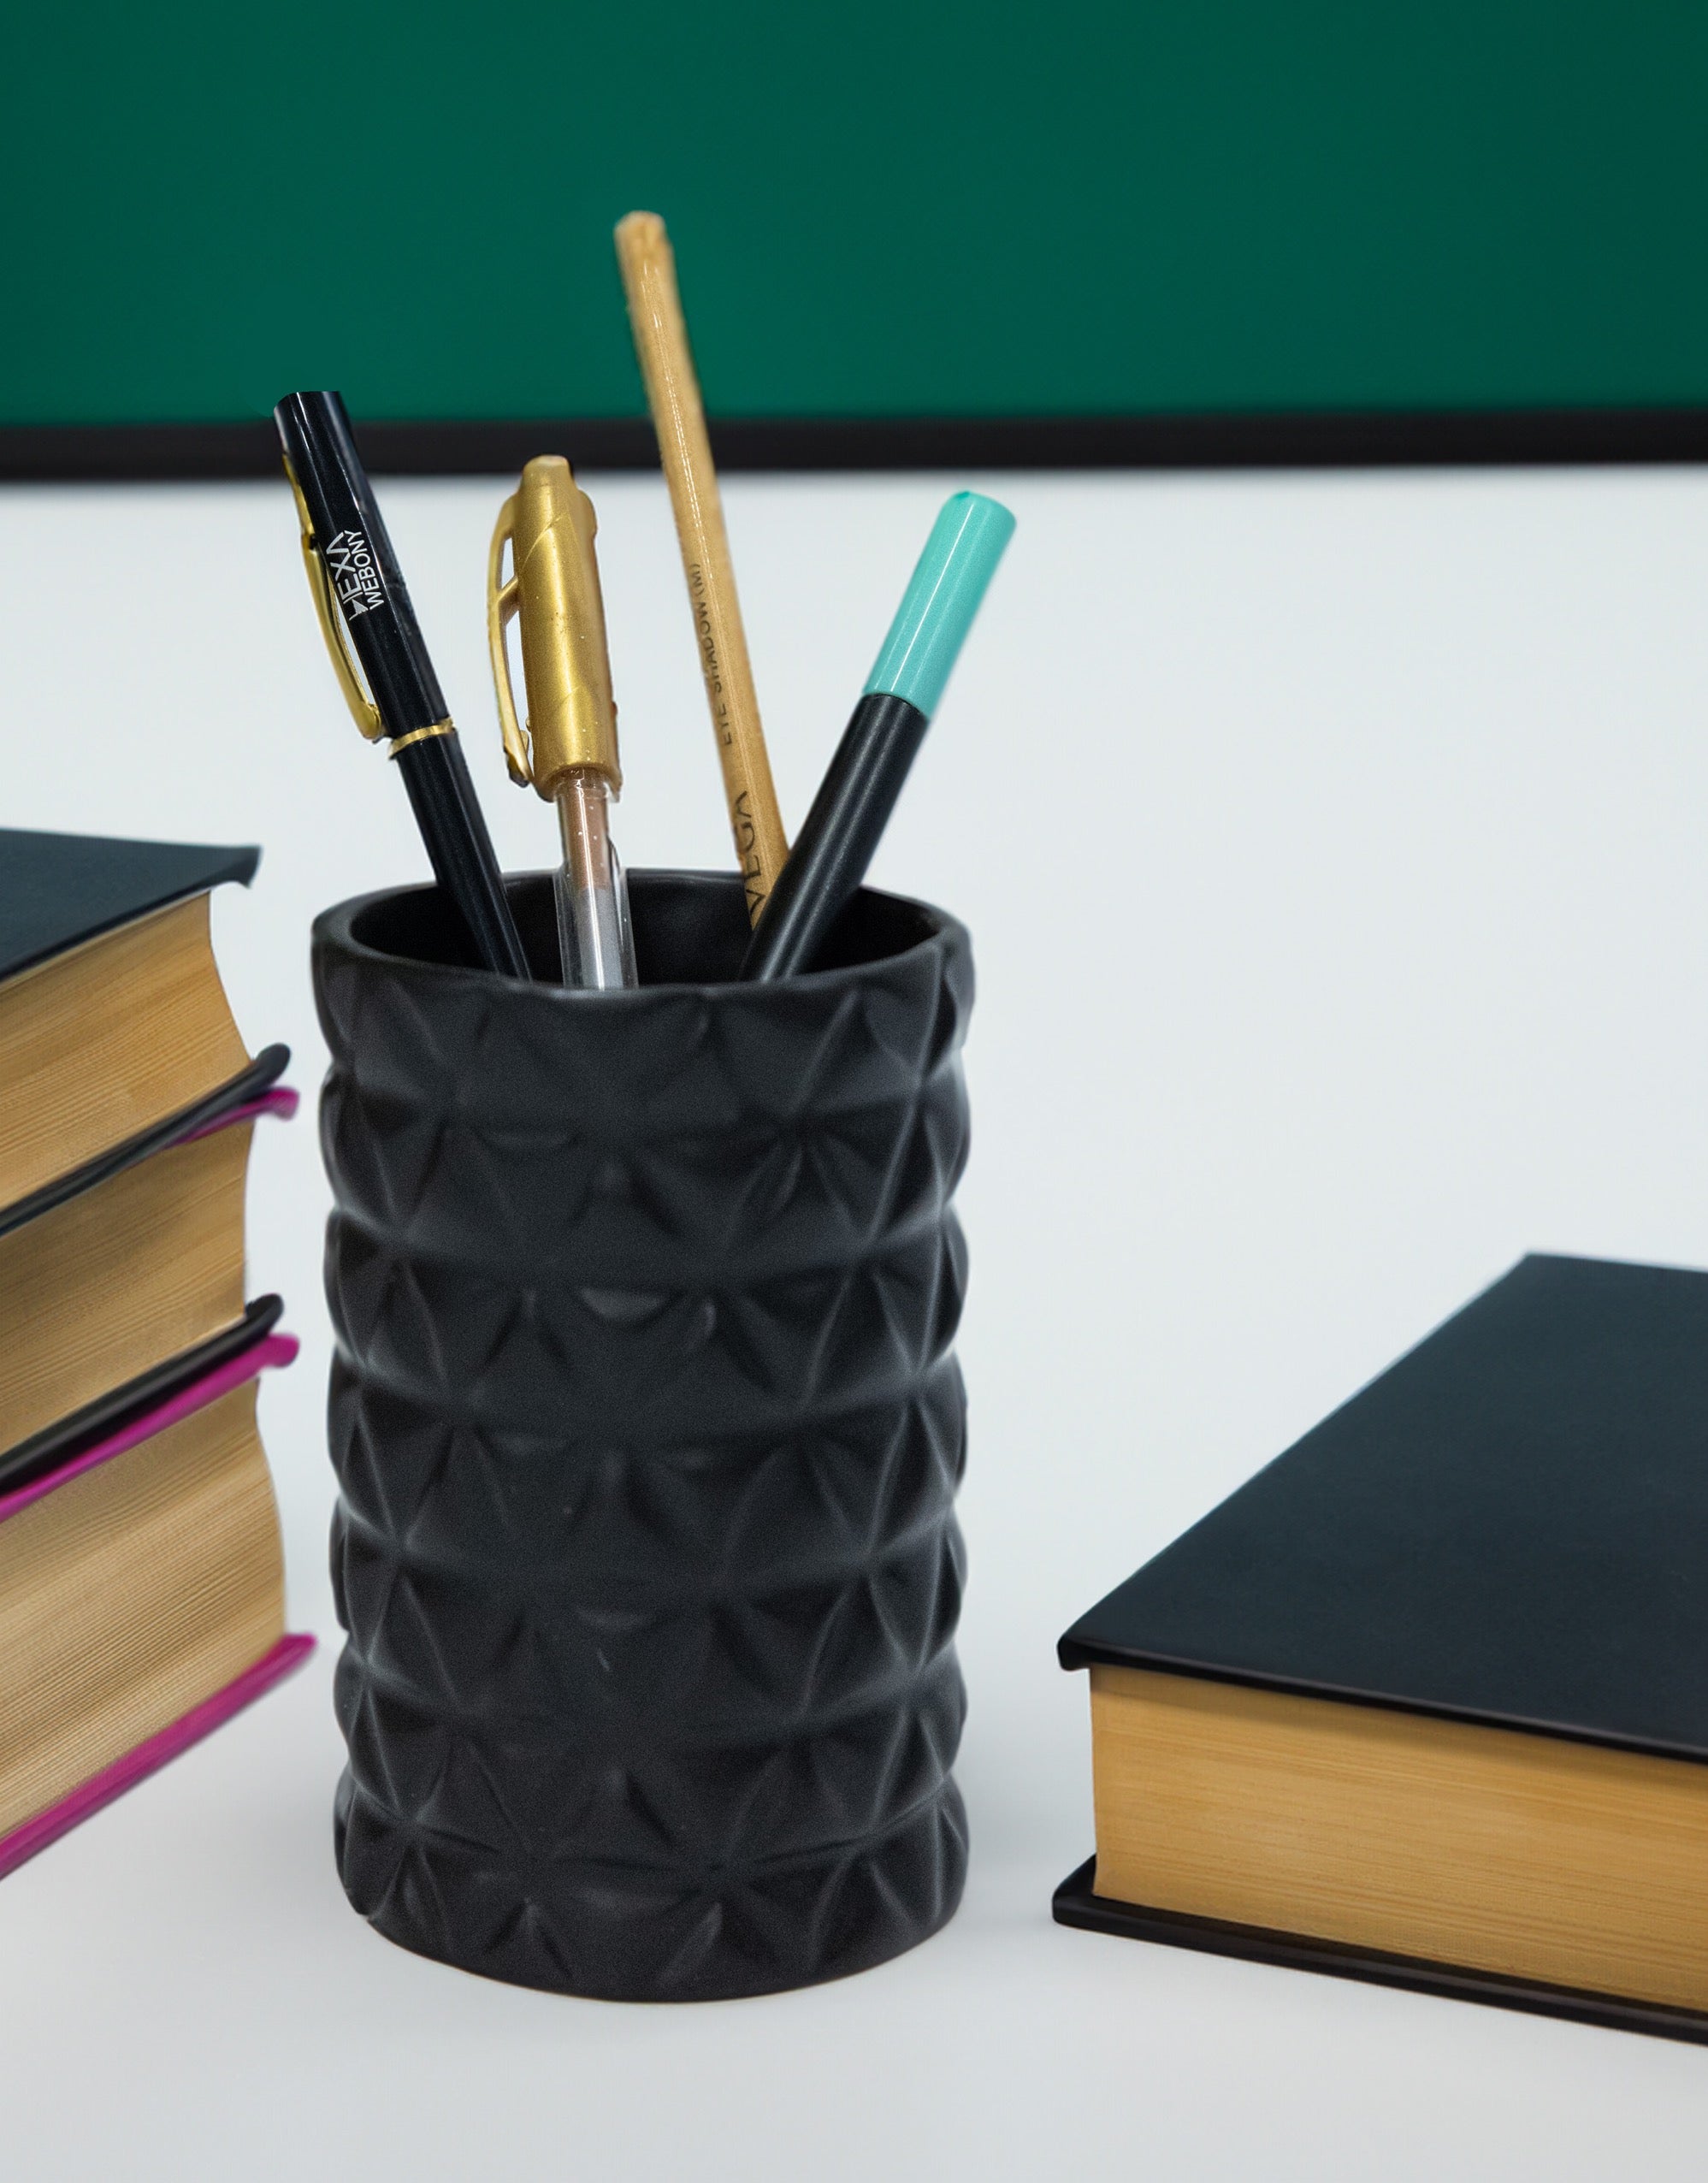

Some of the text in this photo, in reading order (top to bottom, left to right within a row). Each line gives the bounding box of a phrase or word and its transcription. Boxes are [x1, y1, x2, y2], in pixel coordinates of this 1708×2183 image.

[345, 530, 384, 610] WEBONY
[696, 601, 722, 693] SHADOW
[734, 790, 765, 917] VEGA
